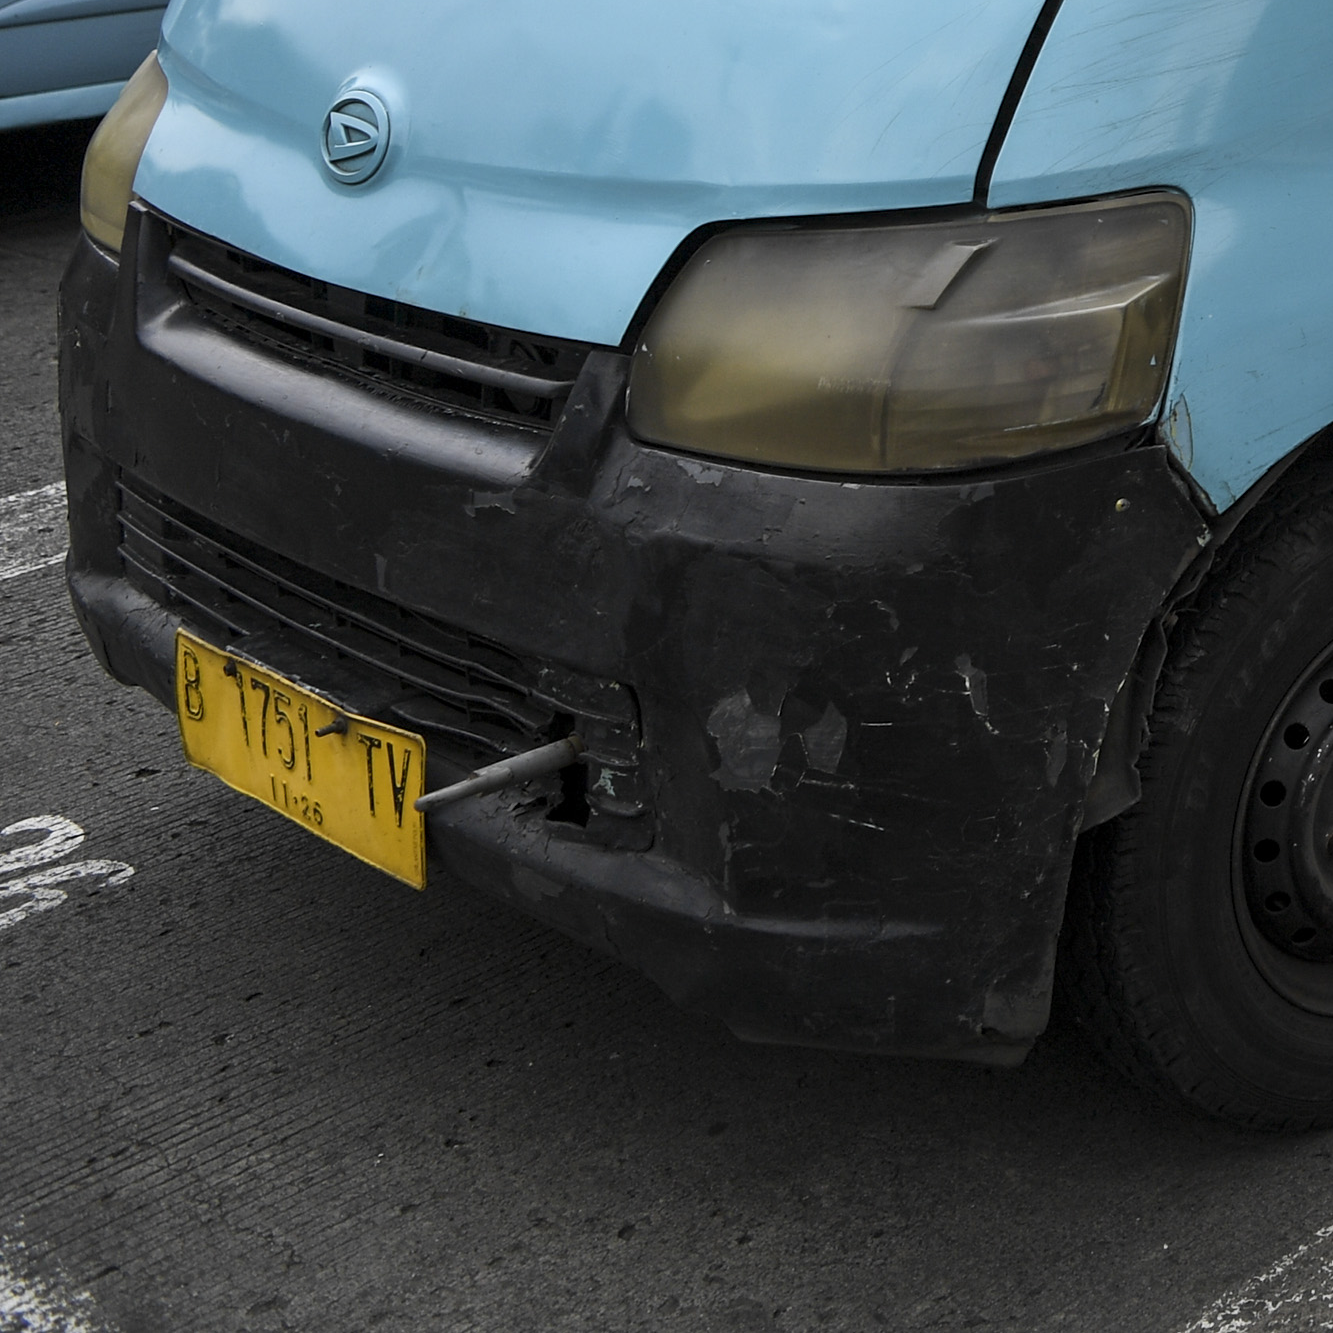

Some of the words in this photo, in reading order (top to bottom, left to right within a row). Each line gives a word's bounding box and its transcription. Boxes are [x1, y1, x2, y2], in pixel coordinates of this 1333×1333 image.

[181, 643, 204, 722] B
[234, 669, 312, 783] 1751
[357, 732, 412, 828] TV
